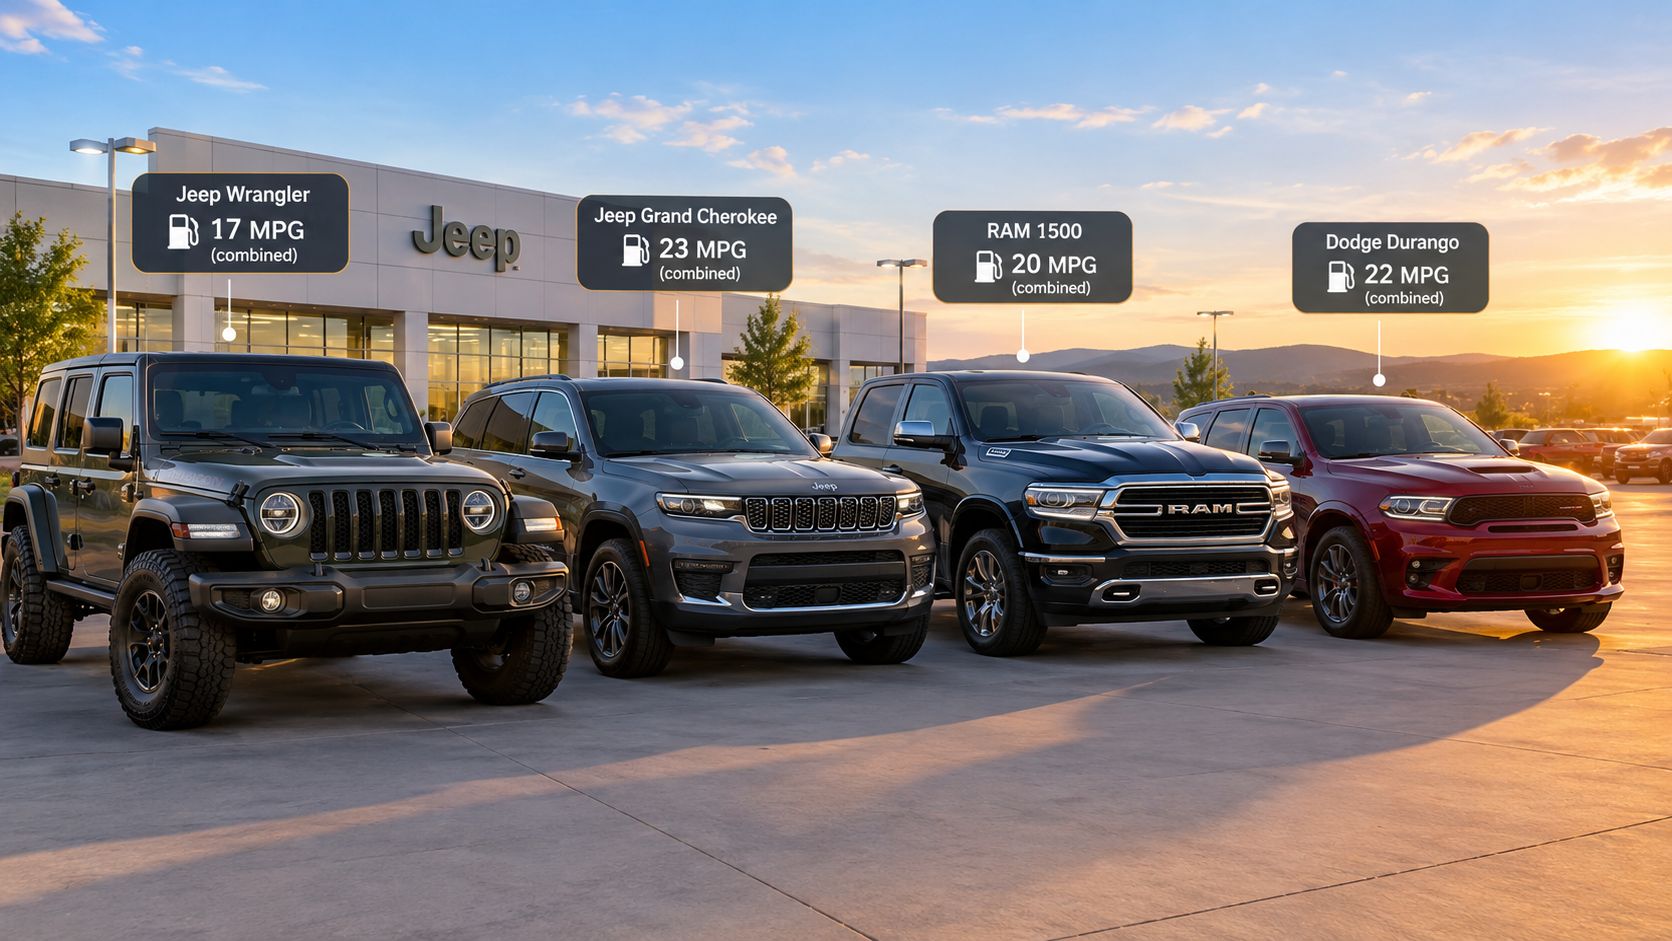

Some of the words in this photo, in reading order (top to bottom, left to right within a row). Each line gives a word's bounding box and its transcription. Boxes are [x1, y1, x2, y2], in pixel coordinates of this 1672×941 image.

[412, 205, 520, 272] Jeep
[812, 481, 838, 491] Jeep
[1168, 503, 1233, 514] RAM
